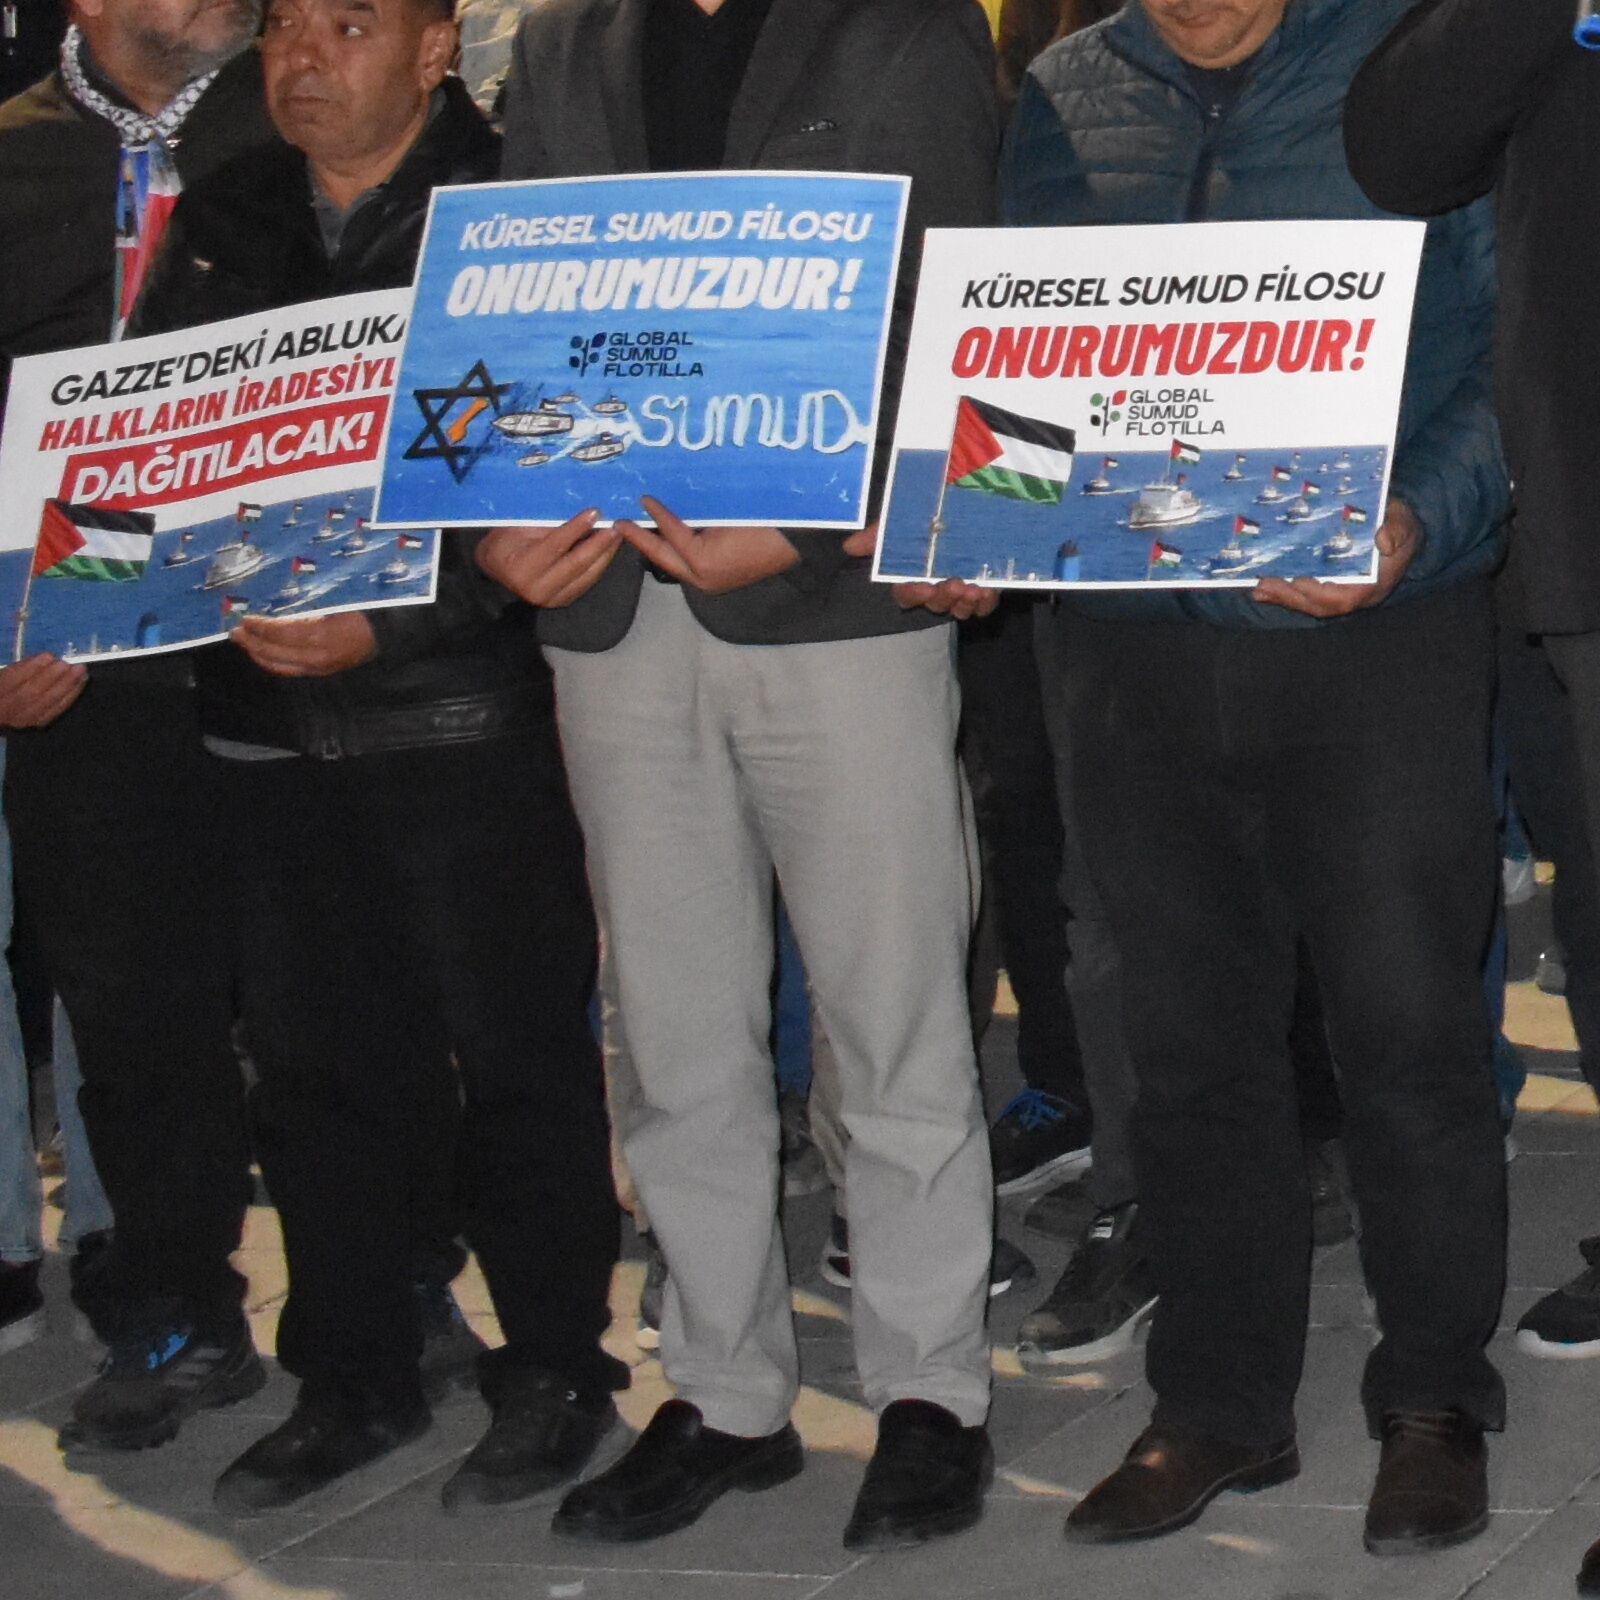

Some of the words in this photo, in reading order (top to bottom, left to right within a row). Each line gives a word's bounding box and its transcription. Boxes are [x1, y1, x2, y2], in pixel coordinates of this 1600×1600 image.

[459, 213, 598, 251] KÜRESEL
[603, 210, 734, 243] SUMUD
[737, 203, 874, 242] FİLOSU
[446, 257, 865, 317] ONURUMUZDUR!
[961, 273, 1111, 309] KÜRESEL
[1118, 273, 1250, 307] SUMUD
[1254, 264, 1387, 302] FİLOSU
[606, 347, 678, 362] SUMUD
[608, 331, 694, 347] GLOBAL
[950, 318, 1377, 379] ONURUMUZDUR!
[50, 328, 269, 406] GAZZE'DEKİ
[603, 361, 705, 377] FLOTILLA
[1127, 404, 1200, 420] SUMUD
[1128, 388, 1216, 404] GLOBAL
[38, 388, 229, 452] HALKLARIN
[1125, 420, 1226, 437] FLOTILLA
[69, 410, 376, 506] DAĞITILACAK!
